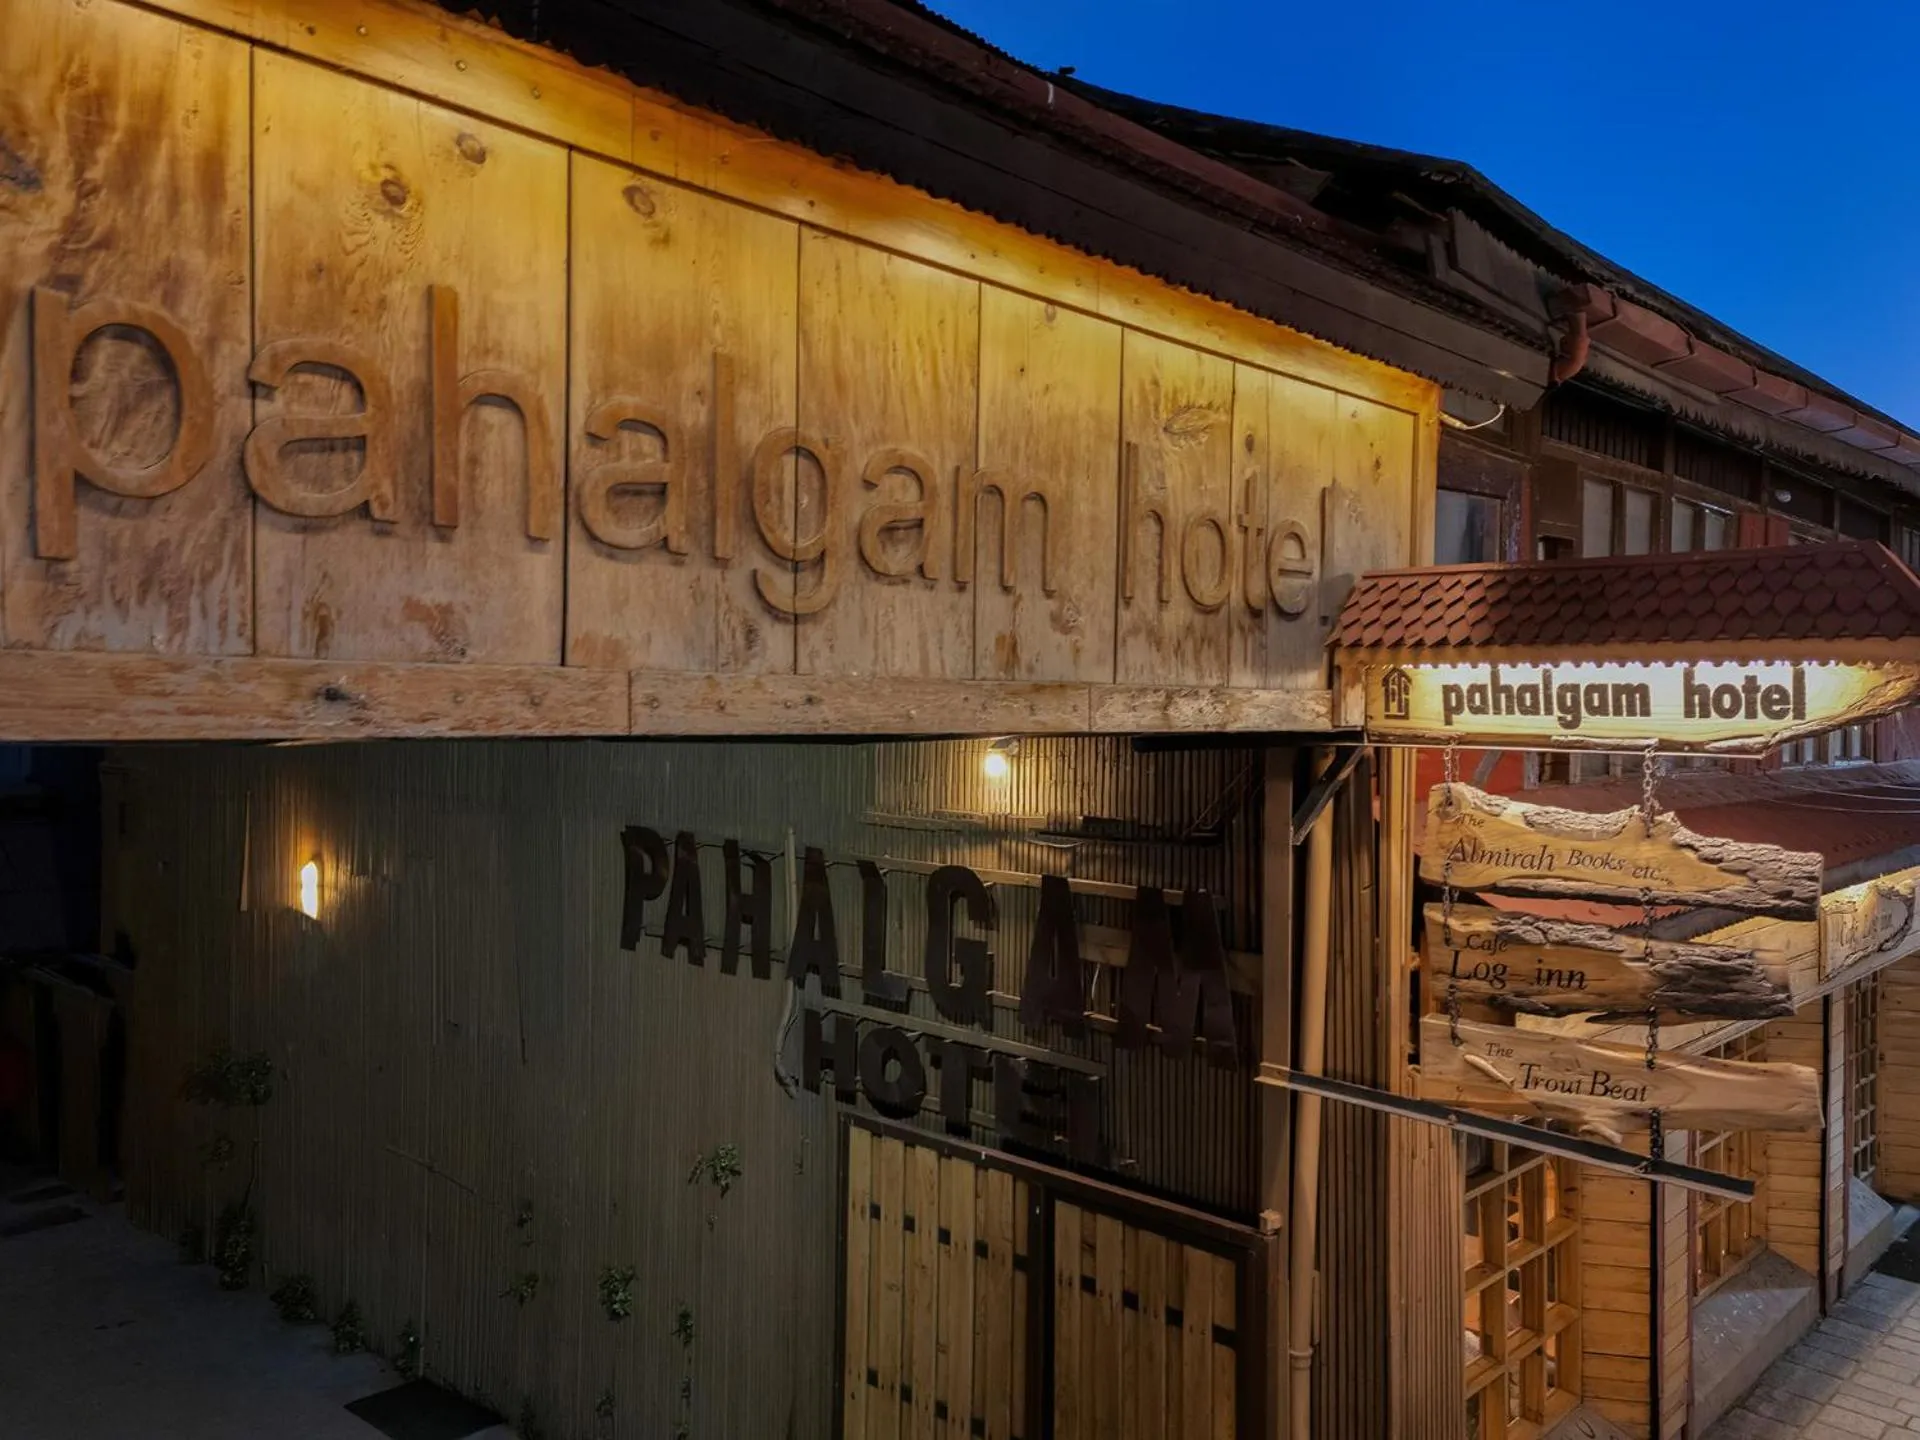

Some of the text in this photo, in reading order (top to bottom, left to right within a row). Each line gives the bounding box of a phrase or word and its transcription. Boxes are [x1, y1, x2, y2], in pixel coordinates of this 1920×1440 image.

[28, 284, 1334, 624] pahalgam hotel
[1442, 666, 1807, 730] pahalgam hotel
[1457, 812, 1485, 829] The
[1446, 837, 1556, 873] Almirah
[1567, 848, 1627, 872] Books
[619, 824, 1238, 1072] PAHALGAM
[1464, 932, 1508, 956] Cafe
[1450, 950, 1588, 991] Log inn
[1486, 1042, 1514, 1058] The
[802, 1008, 1134, 1172] HOTEL
[1518, 1062, 1648, 1103] Trout Beat
